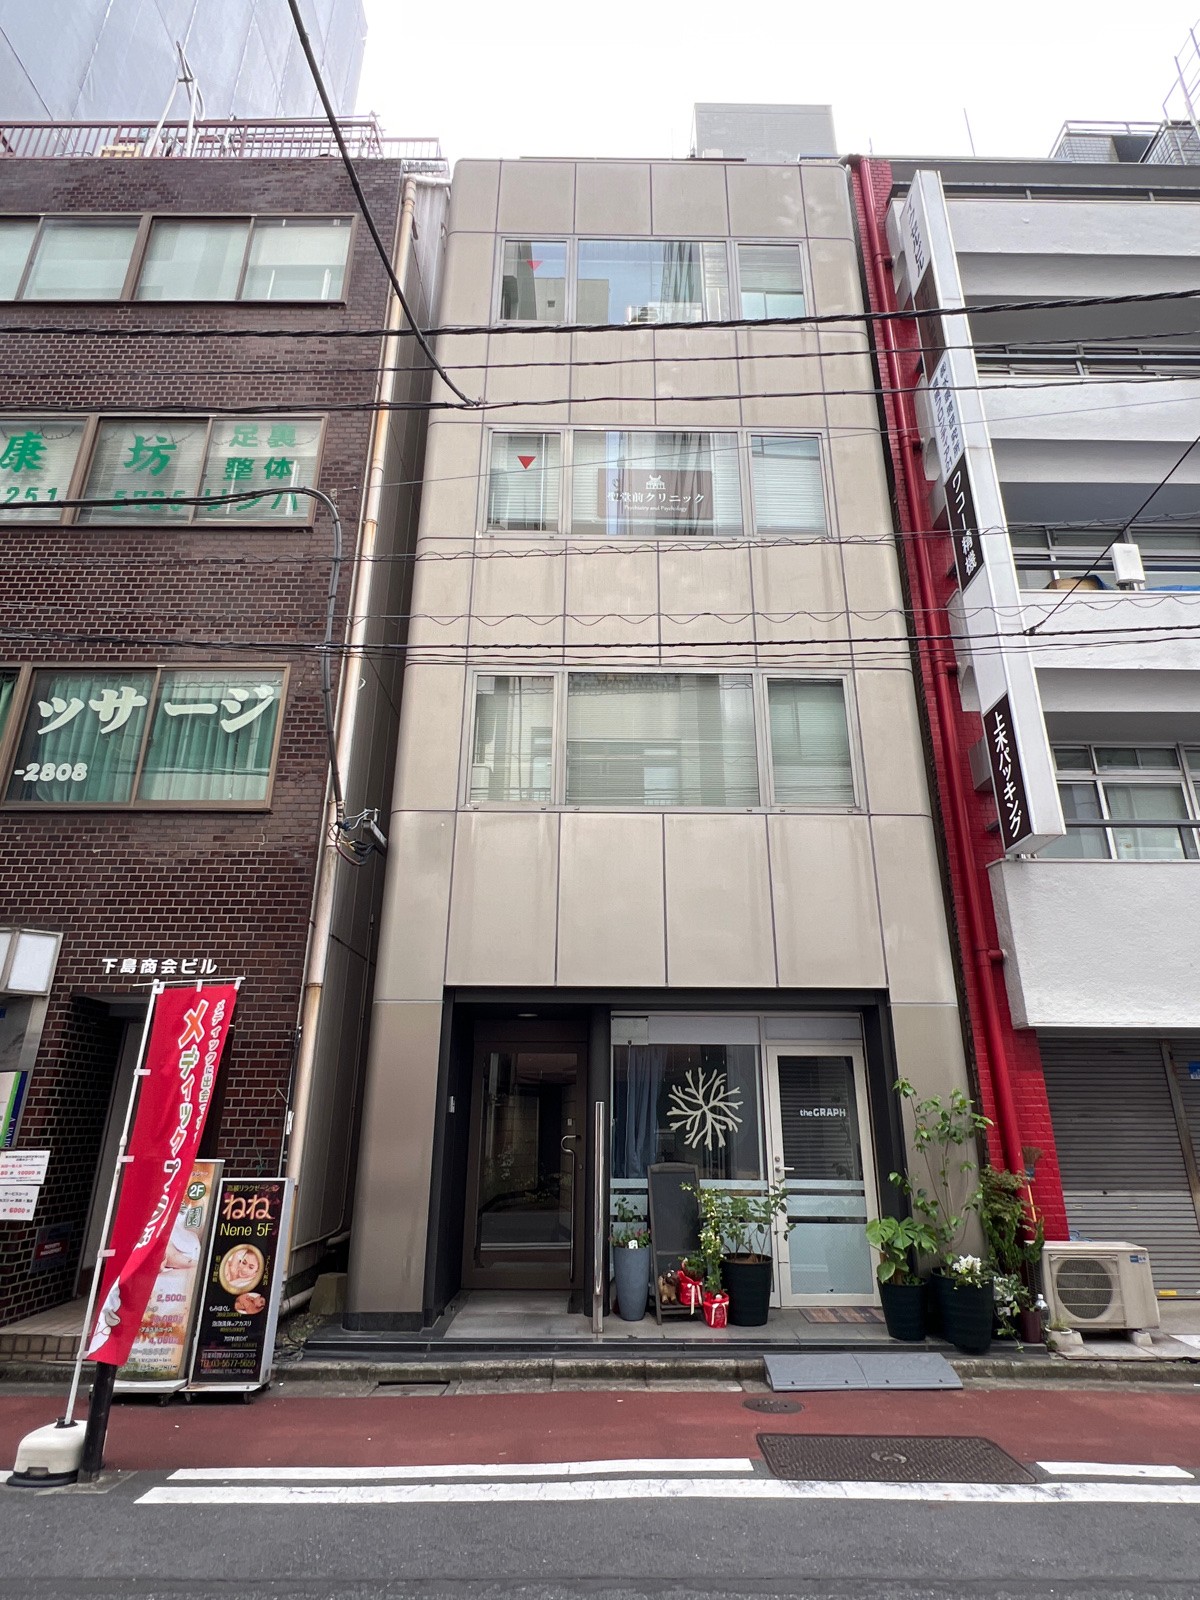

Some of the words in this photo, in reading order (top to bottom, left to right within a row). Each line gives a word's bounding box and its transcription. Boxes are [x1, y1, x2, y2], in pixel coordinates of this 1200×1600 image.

[229, 424, 297, 448] 足裏
[223, 456, 294, 481] 整体
[14, 762, 88, 782] -2808
[993, 711, 1022, 839] 上木パッキング
[102, 957, 219, 976] 下島商会ビル
[799, 1108, 846, 1117] theGRAPH
[189, 1184, 205, 1197] 2F
[222, 1194, 276, 1221] ねね
[220, 1223, 252, 1237] Nene
[256, 1222, 274, 1237] 5F
